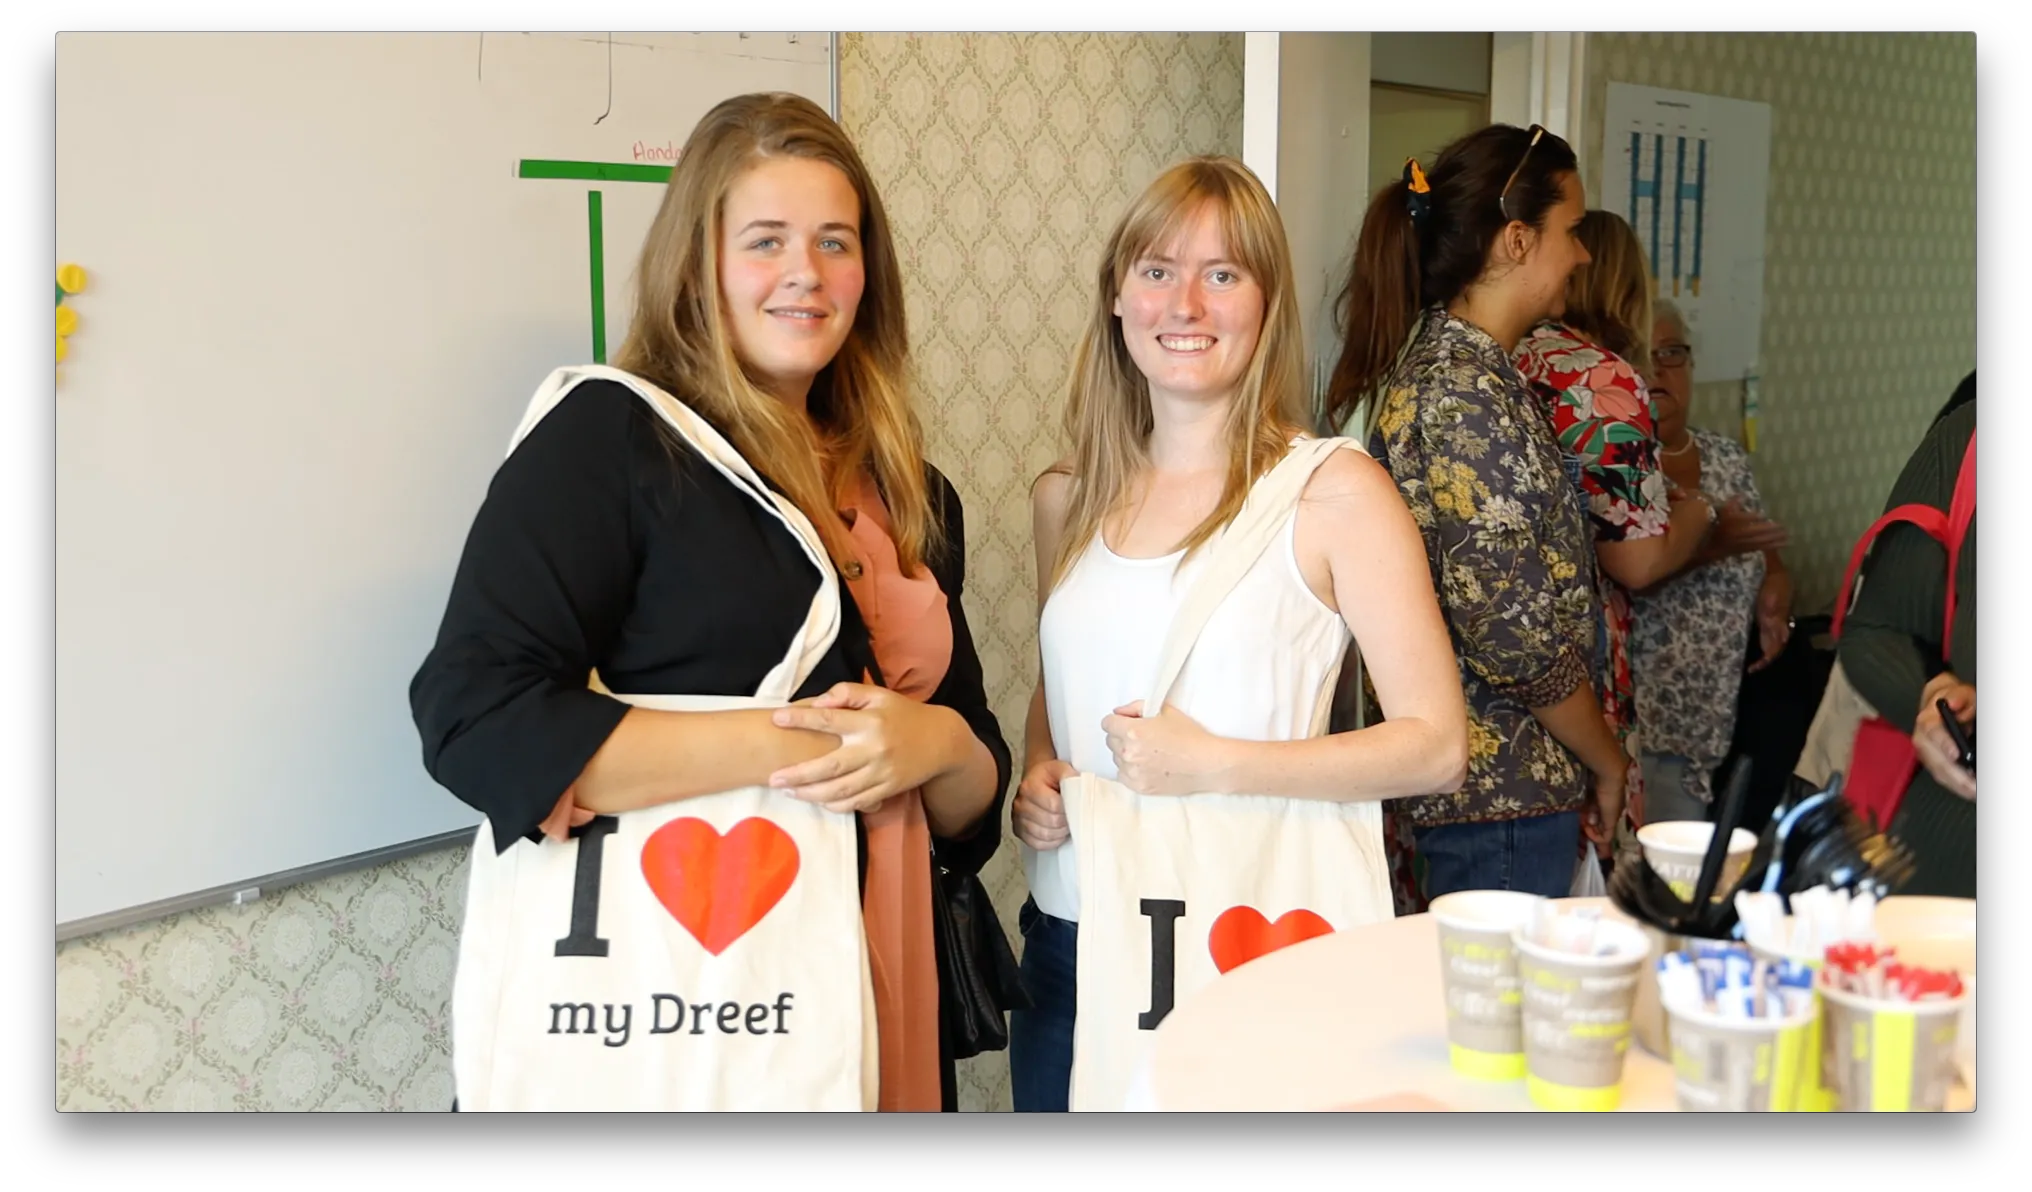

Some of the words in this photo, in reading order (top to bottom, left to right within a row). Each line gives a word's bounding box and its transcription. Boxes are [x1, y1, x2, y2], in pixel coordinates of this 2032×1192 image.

[554, 815, 619, 958] I
[547, 1002, 632, 1048] my
[649, 992, 794, 1034] Dreef
